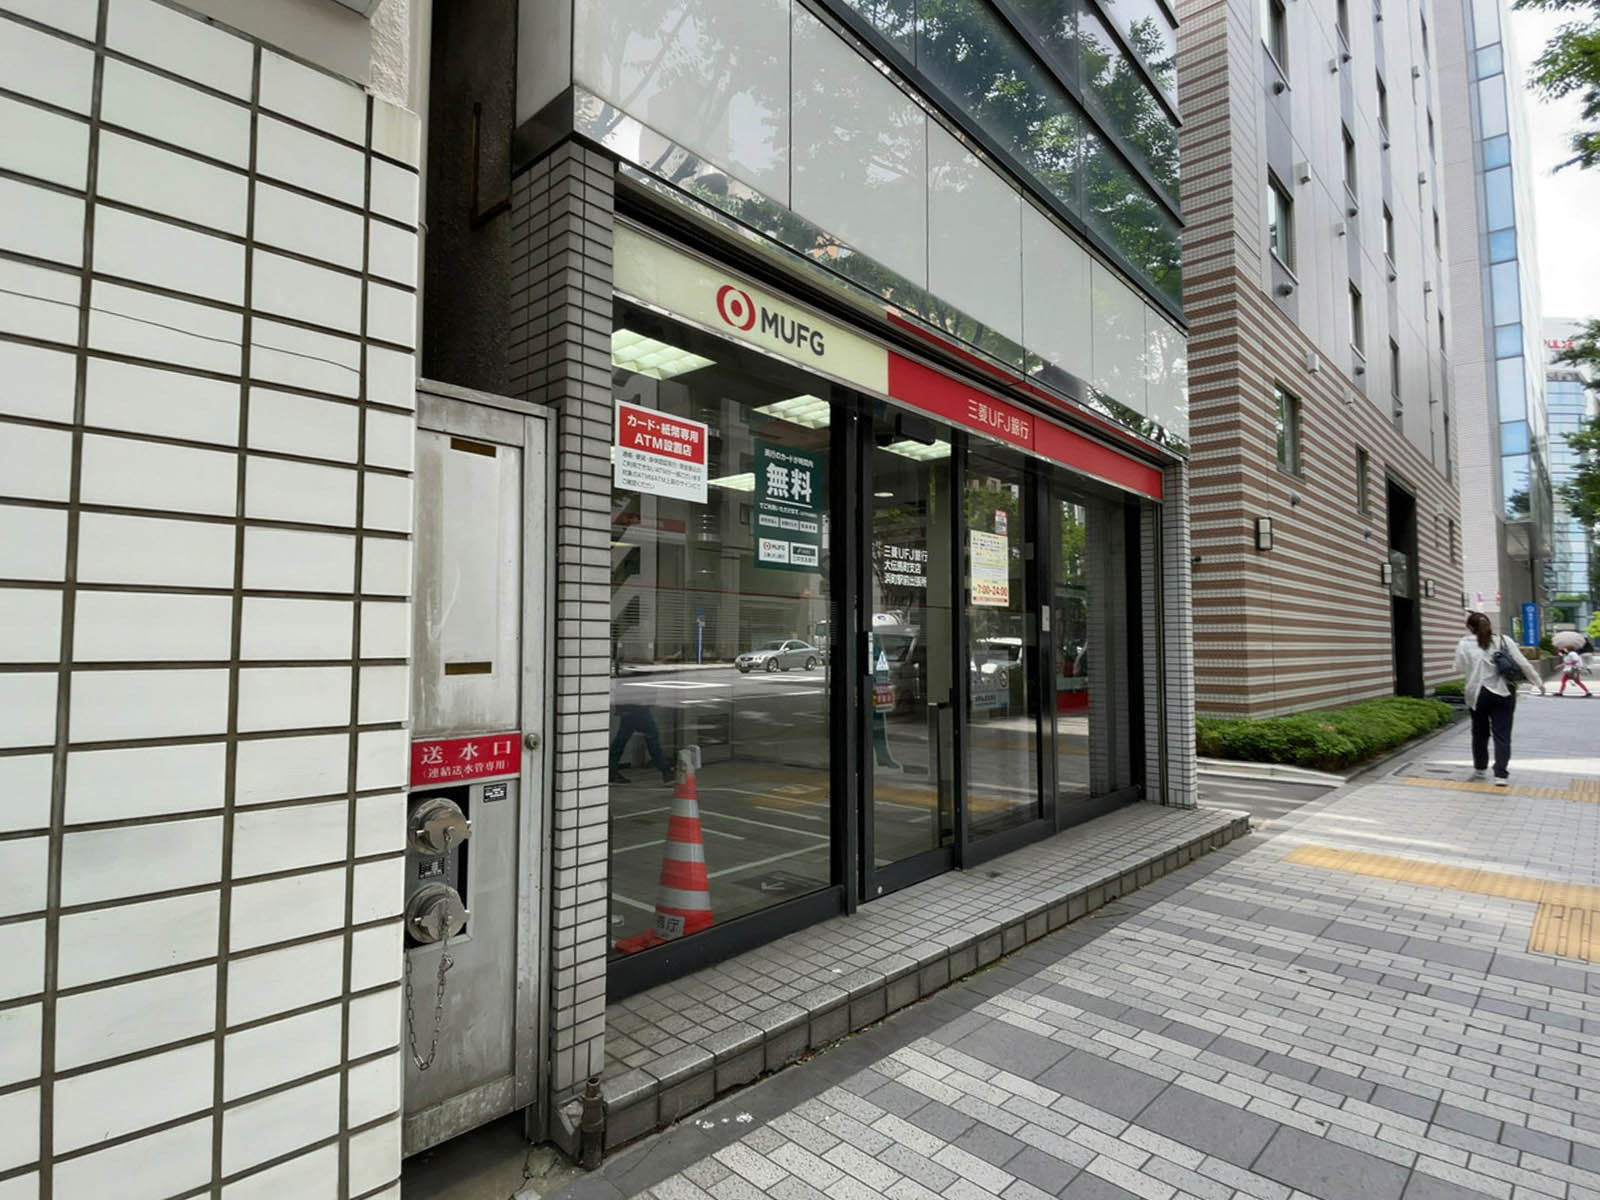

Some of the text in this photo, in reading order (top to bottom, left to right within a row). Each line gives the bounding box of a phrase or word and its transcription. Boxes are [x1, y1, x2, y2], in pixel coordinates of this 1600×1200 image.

[761, 306, 824, 356] MUFG
[968, 398, 1029, 440] 三菱UFJ銀行
[634, 432, 692, 457] ATM設置店
[766, 462, 812, 503] 無料
[884, 545, 928, 562] 三菱UFJ銀行
